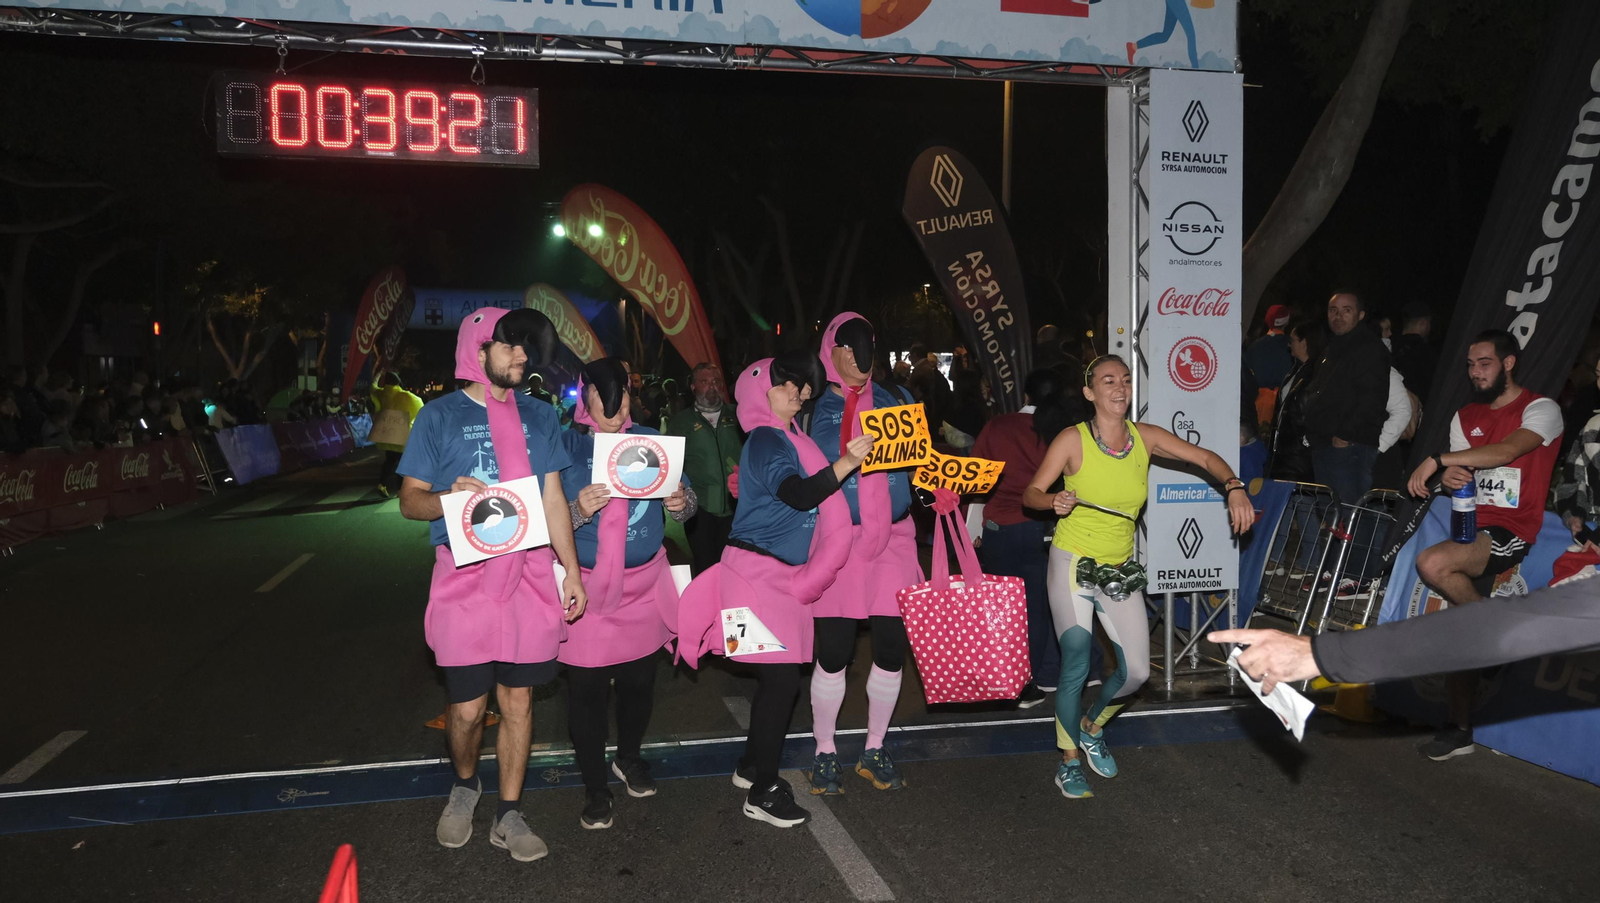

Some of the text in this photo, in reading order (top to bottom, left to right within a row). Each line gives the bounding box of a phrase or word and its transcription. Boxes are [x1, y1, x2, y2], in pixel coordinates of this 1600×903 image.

[271, 84, 525, 154] 00:39:21
[1161, 151, 1228, 164] RENAULT
[1161, 164, 1227, 174] SYRSA AUTOMOCION
[1162, 223, 1224, 233] NISSAN
[1169, 258, 1222, 267] andalmotor.es
[1157, 287, 1234, 316] Coca-Cola
[357, 271, 402, 354] Coca-Cola
[462, 425, 473, 433] XIV
[865, 409, 914, 442] SOS
[464, 432, 485, 440] CIUDAD
[610, 439, 637, 462] SALVEMOS
[648, 441, 667, 464] SALINAS
[864, 438, 927, 466] SALINAS
[923, 452, 981, 481] SOS
[63, 461, 98, 493] Coca-Cola
[1160, 487, 1206, 501] Almericar
[464, 489, 524, 523] SALVEMOS LAS SALINAS
[1157, 567, 1223, 580] RENAULT
[1157, 580, 1222, 590] SYRSA AUTOMOCION
[737, 623, 747, 638] 7
